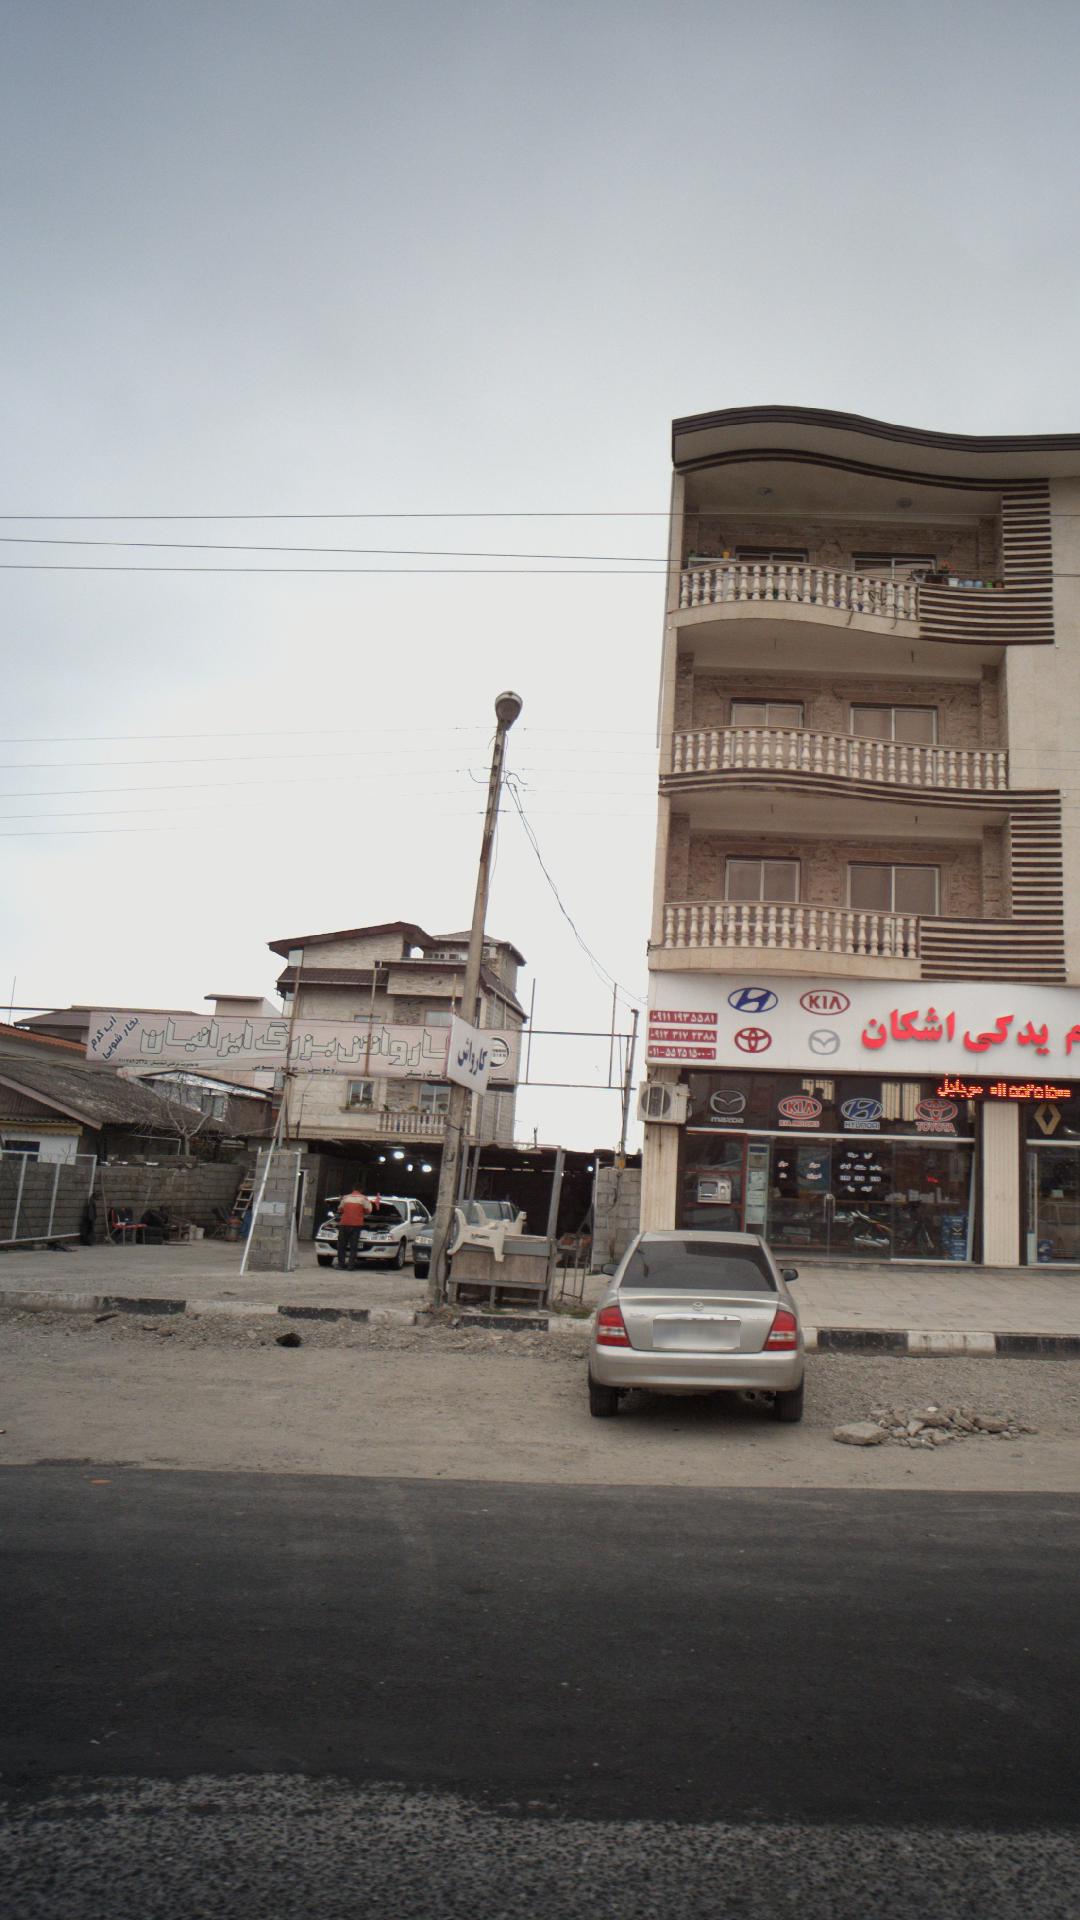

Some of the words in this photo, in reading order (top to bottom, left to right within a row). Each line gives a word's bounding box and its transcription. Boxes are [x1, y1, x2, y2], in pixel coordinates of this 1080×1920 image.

[808, 995, 842, 1010] KIA
[140, 1017, 253, 1057] ایرانیان
[255, 1021, 336, 1061] بزرگ
[337, 1026, 448, 1067] ارواش
[861, 1007, 955, 1050] اشکان
[964, 1014, 1050, 1056] یدکی
[786, 1101, 816, 1115] KIA
[843, 1121, 881, 1130] HYUNDAI
[915, 1121, 956, 1133] TOYOTA
